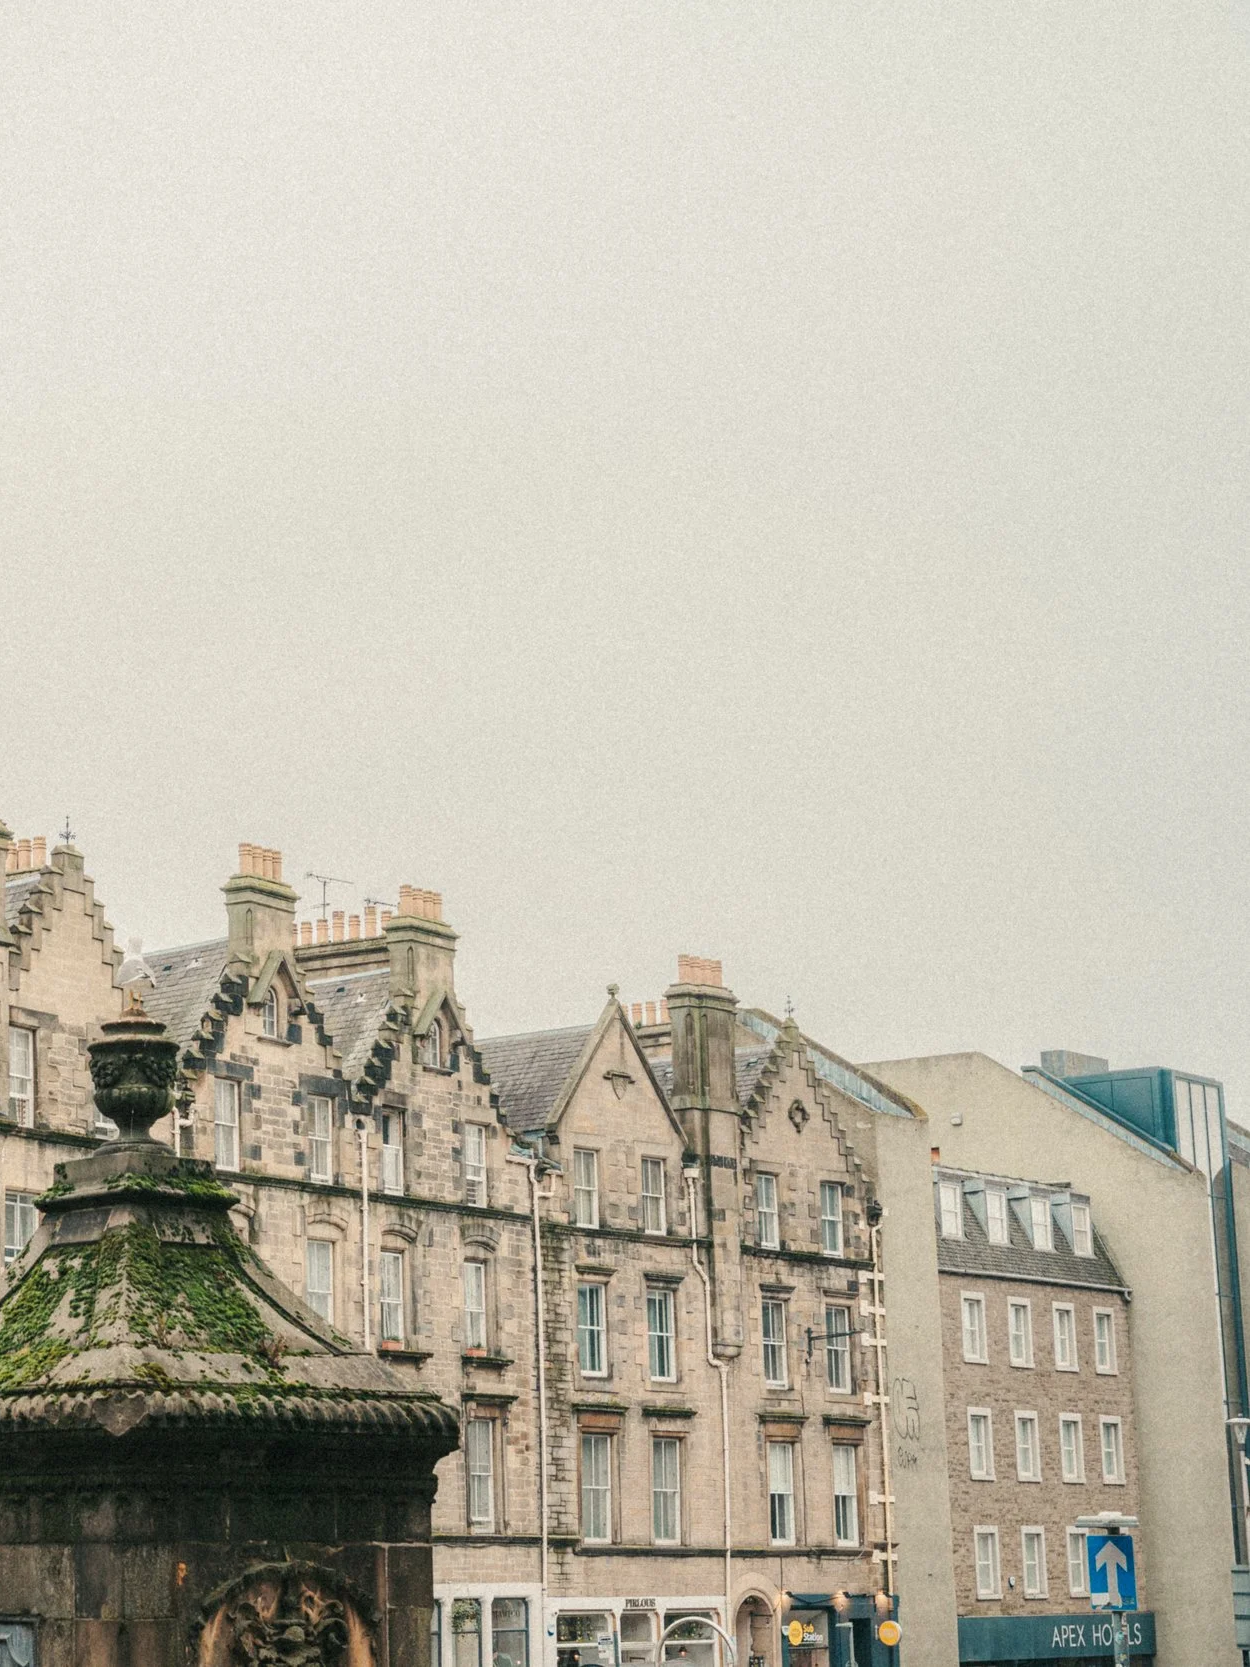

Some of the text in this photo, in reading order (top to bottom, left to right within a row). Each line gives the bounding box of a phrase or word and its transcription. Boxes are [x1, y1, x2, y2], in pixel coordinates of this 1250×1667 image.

[803, 1623, 814, 1633] Sub
[1052, 1623, 1142, 1647] APEX HOLS
